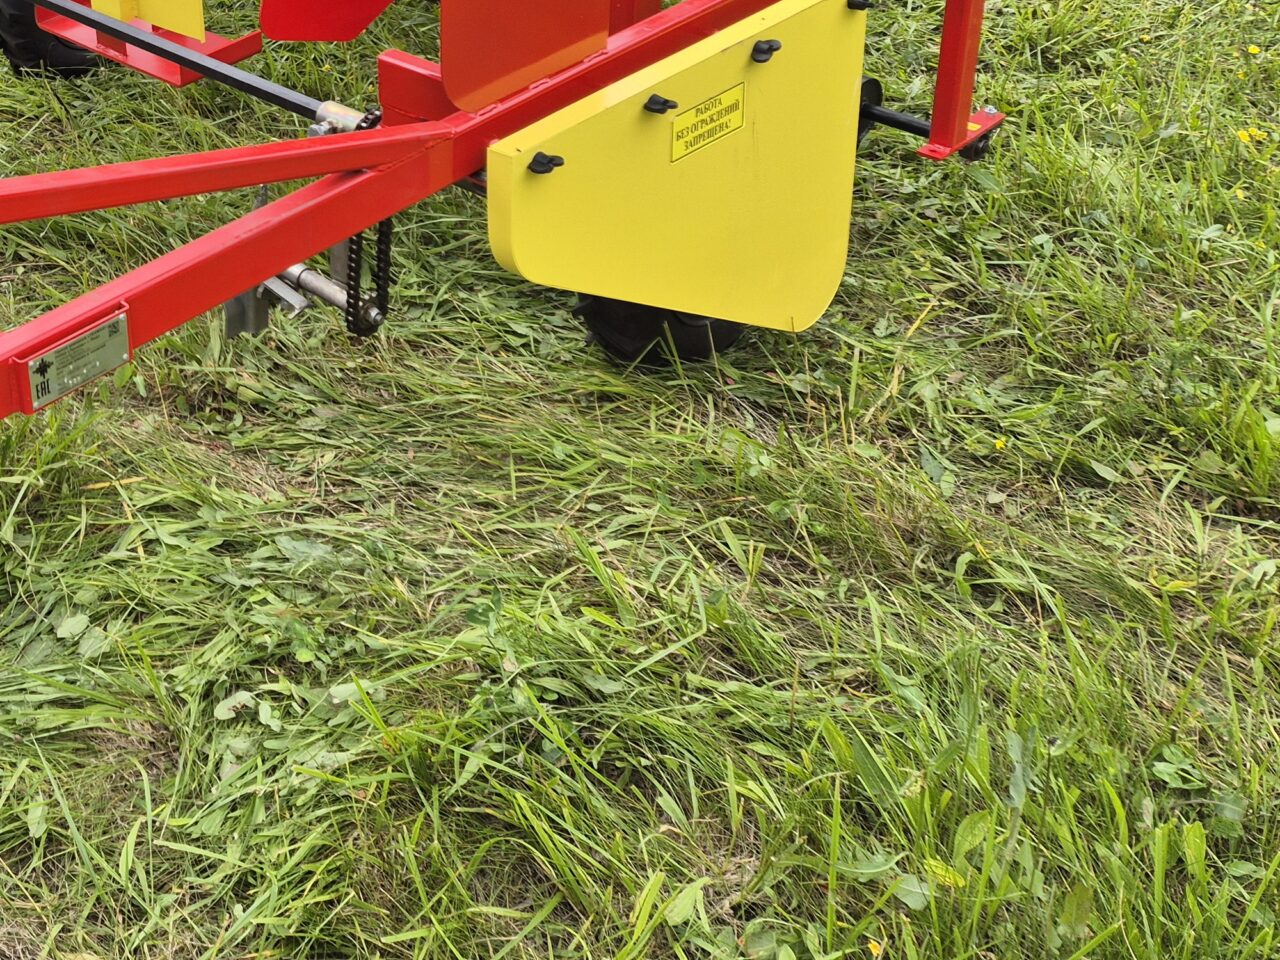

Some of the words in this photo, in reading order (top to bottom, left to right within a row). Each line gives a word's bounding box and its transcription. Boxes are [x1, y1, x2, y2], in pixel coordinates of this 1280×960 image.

[676, 125, 690, 142] БЕЗ
[690, 99, 740, 135] ОГРАЖДЕНИЙ
[695, 97, 723, 118] РАБОТА
[683, 118, 732, 151] ЗАПРЕЩЕНА!
